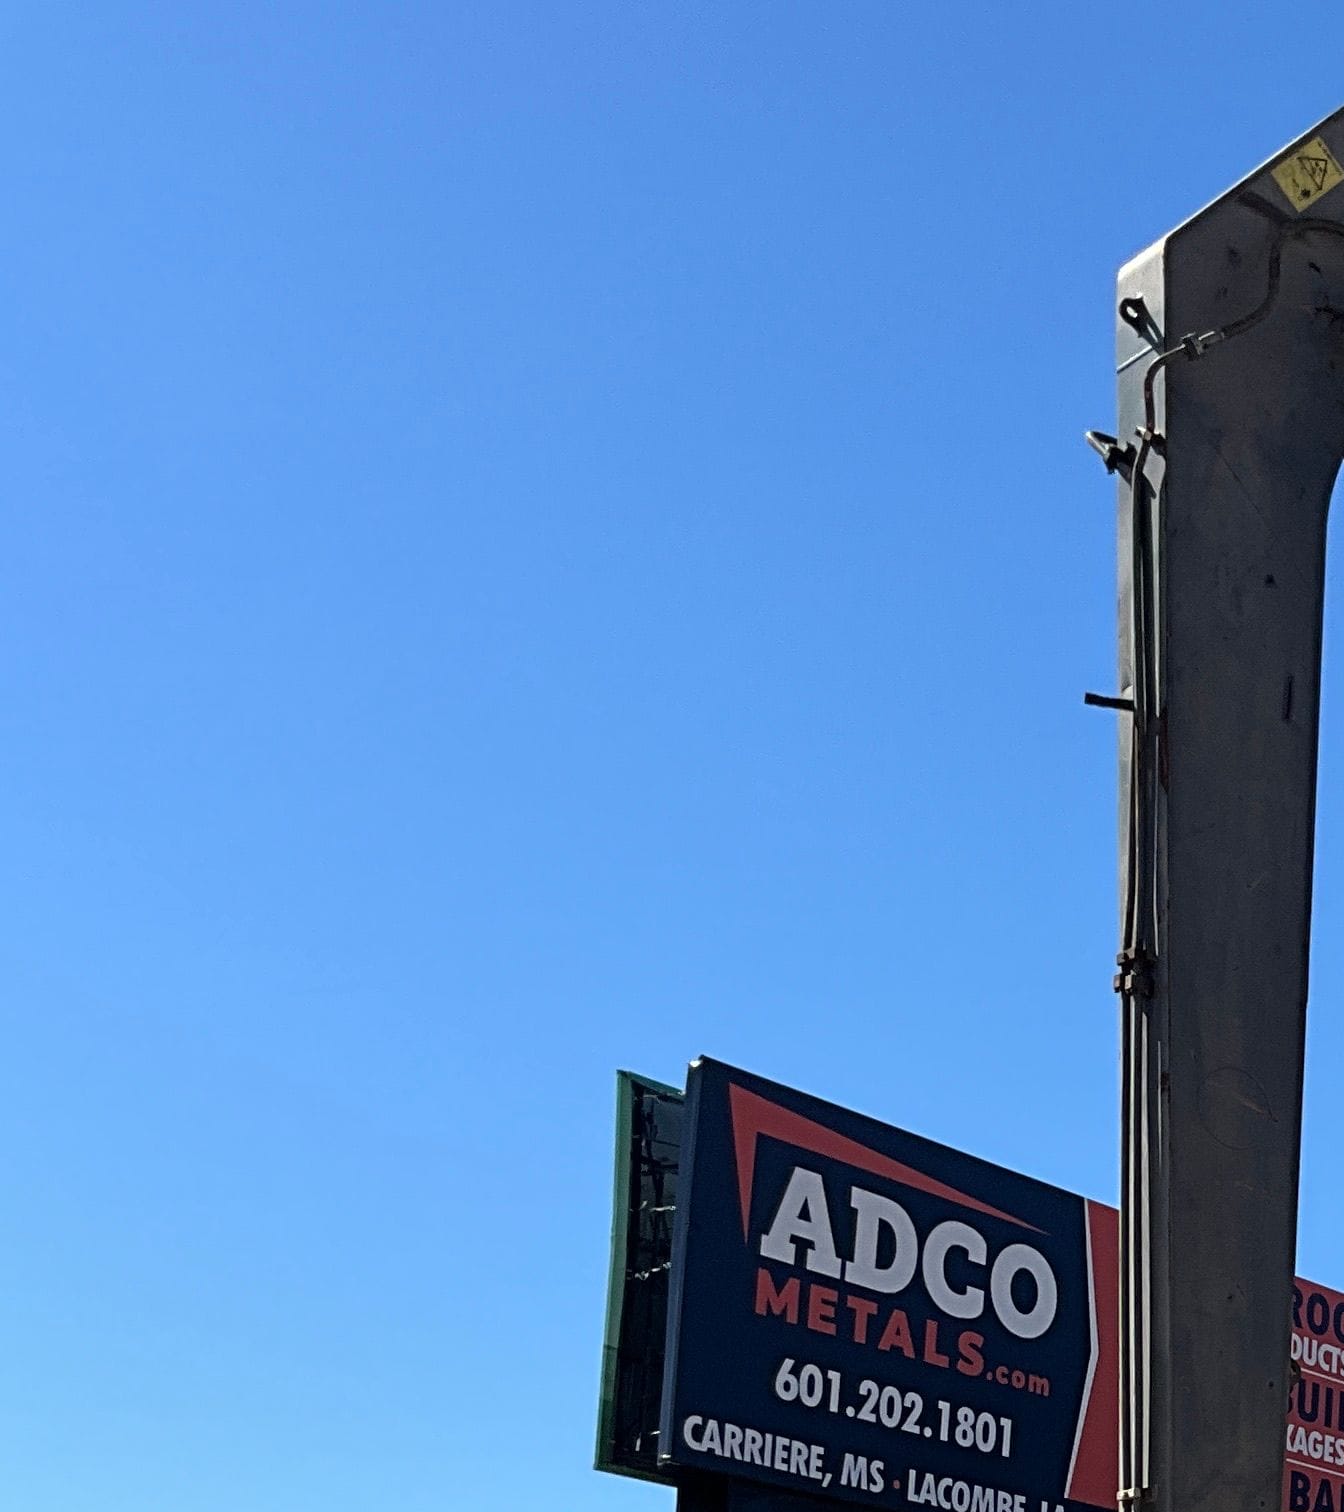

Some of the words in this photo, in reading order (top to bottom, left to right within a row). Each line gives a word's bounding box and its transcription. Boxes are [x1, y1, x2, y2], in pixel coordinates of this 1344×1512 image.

[760, 1166, 1057, 1339] ADCO
[755, 1267, 1050, 1396] METALS.com
[683, 1415, 832, 1488] CARRIERE,
[840, 1452, 884, 1494] MS
[775, 1358, 1013, 1457] 601.202.1801
